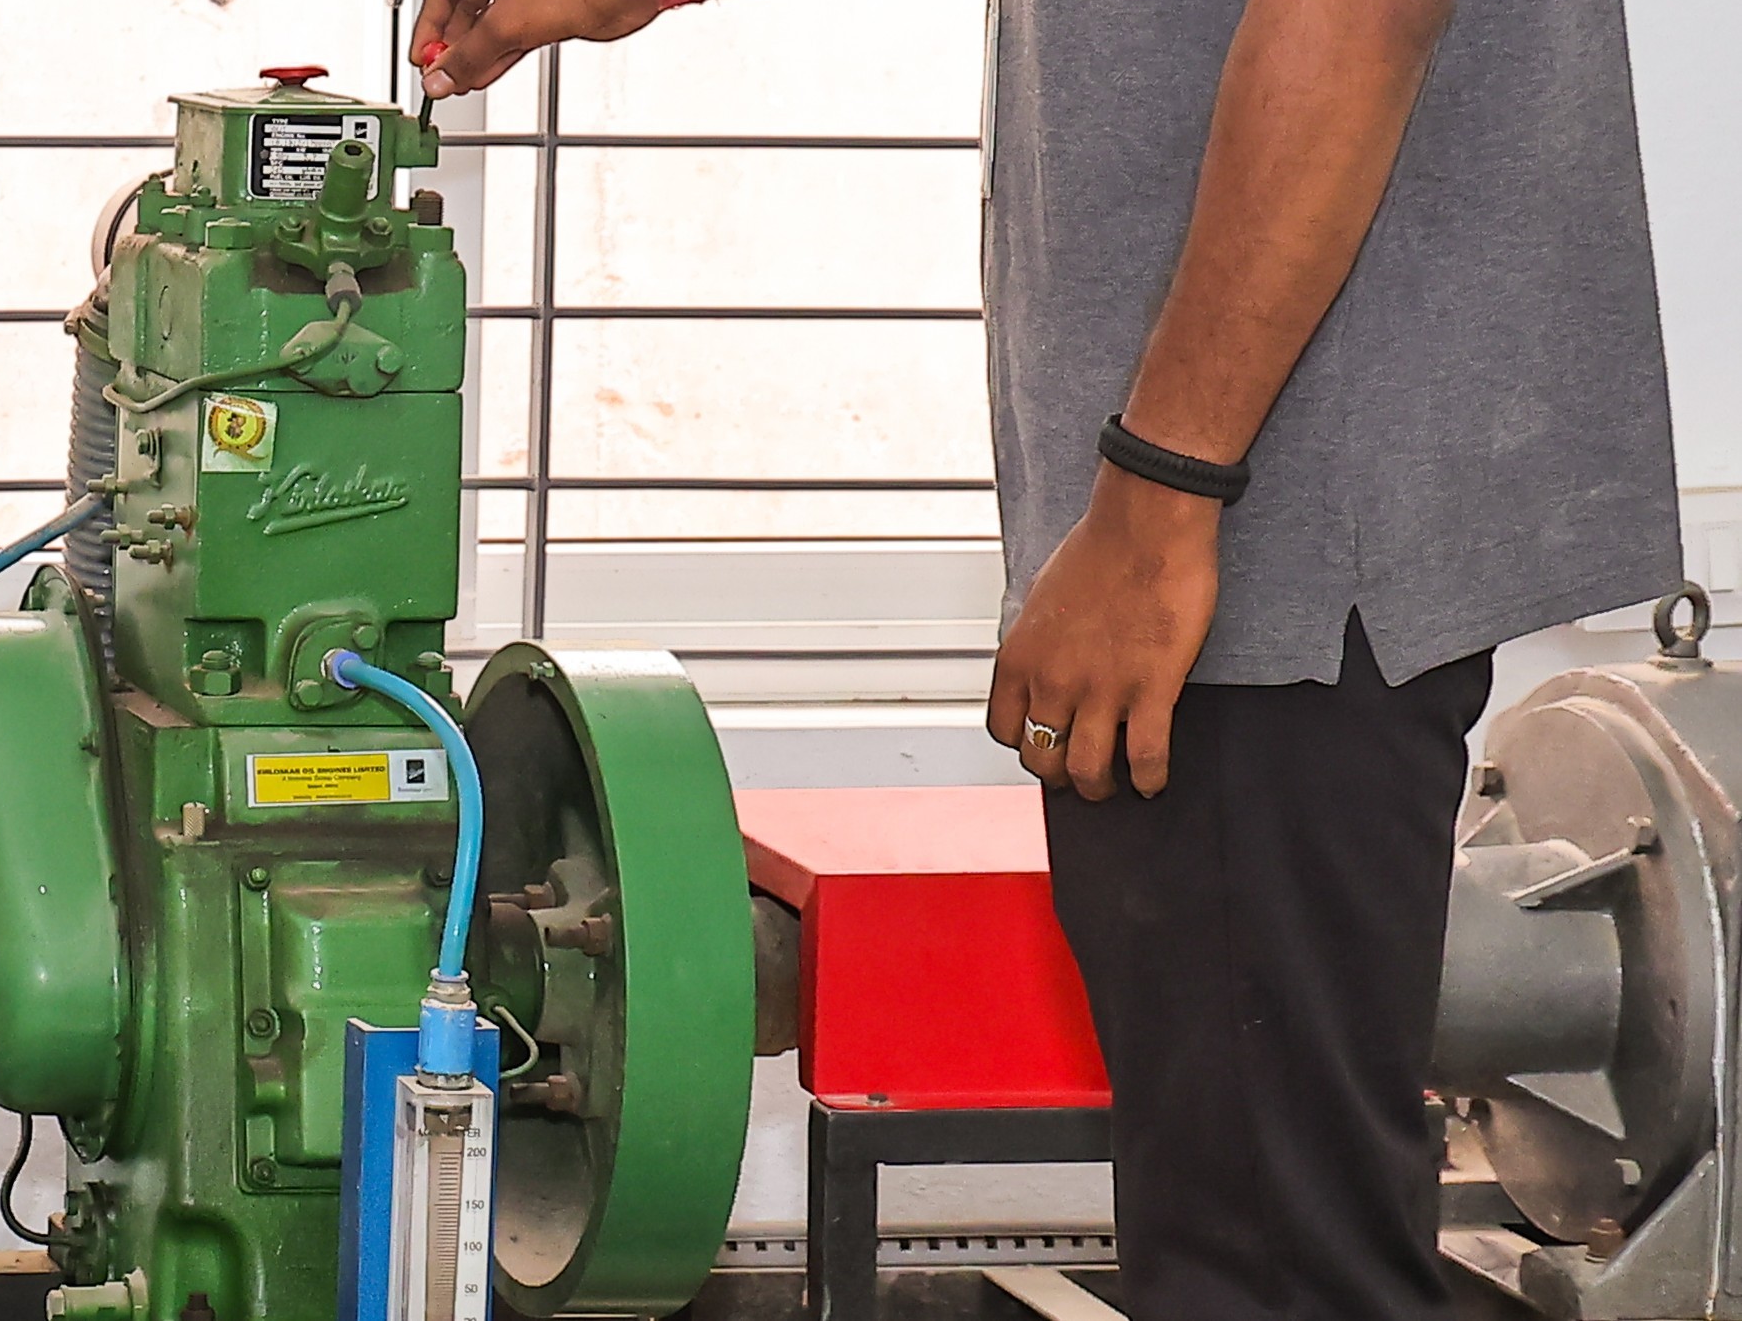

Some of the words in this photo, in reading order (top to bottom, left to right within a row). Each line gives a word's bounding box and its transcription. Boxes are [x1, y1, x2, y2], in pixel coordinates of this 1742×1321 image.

[317, 766, 352, 774] ENGINES
[467, 1147, 487, 1157] 200
[465, 1200, 485, 1211] 150
[463, 1242, 482, 1252] 100
[464, 1284, 478, 1294] 50
